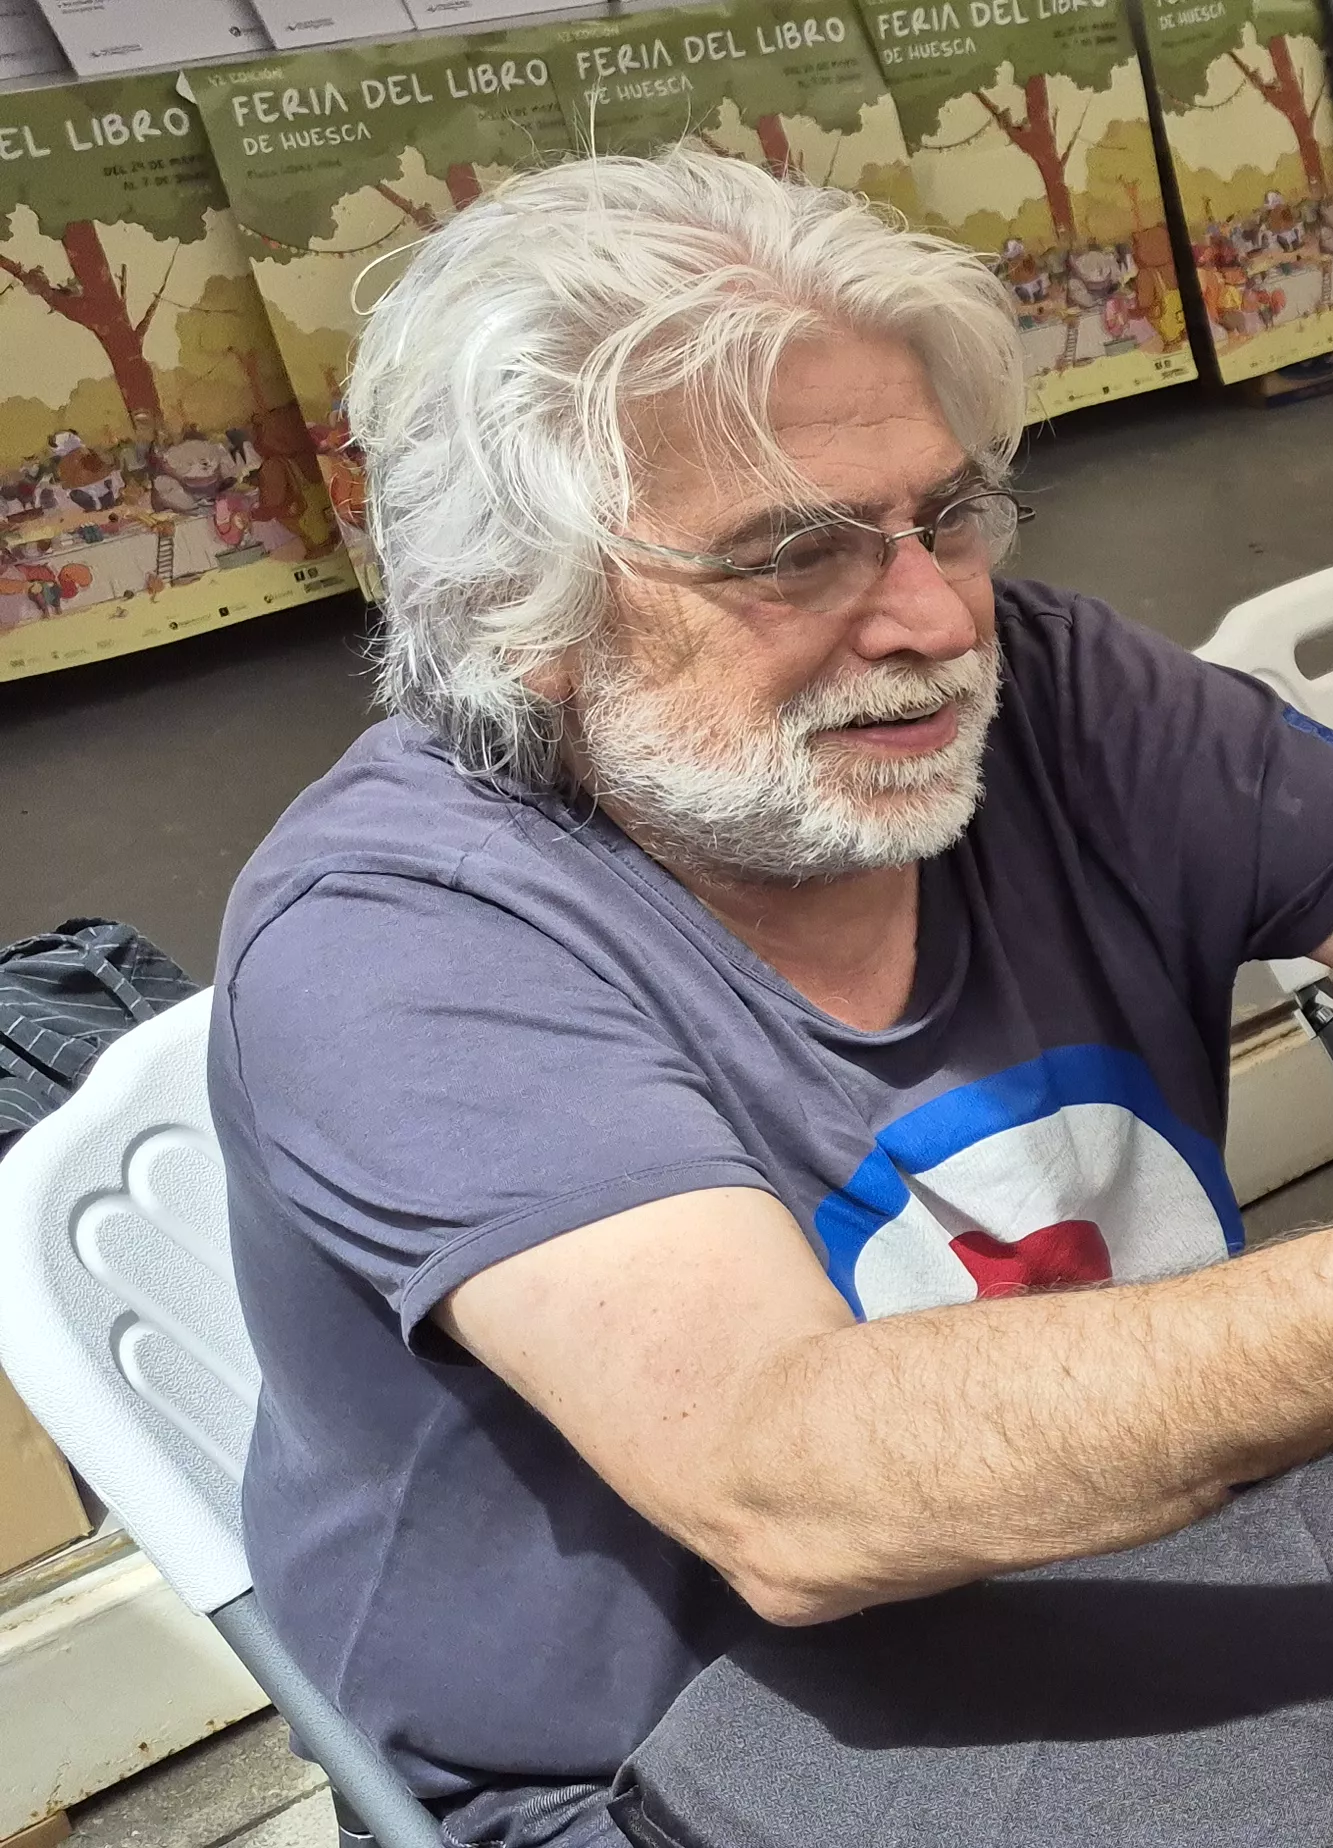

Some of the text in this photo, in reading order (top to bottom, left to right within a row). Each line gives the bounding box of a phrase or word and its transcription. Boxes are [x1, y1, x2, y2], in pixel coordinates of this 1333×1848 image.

[878, 0, 1107, 40] FERIA DEL LIB
[576, 16, 846, 80] FERIA DEL LIBRO
[882, 36, 977, 65] DE HUESCA
[231, 81, 349, 127] FERIA
[361, 73, 433, 110] DEL
[446, 58, 549, 99] LIBRO
[616, 72, 694, 101] HUESCA
[0, 107, 190, 160] EL LIBRO
[242, 121, 372, 156] DE HUESCA
